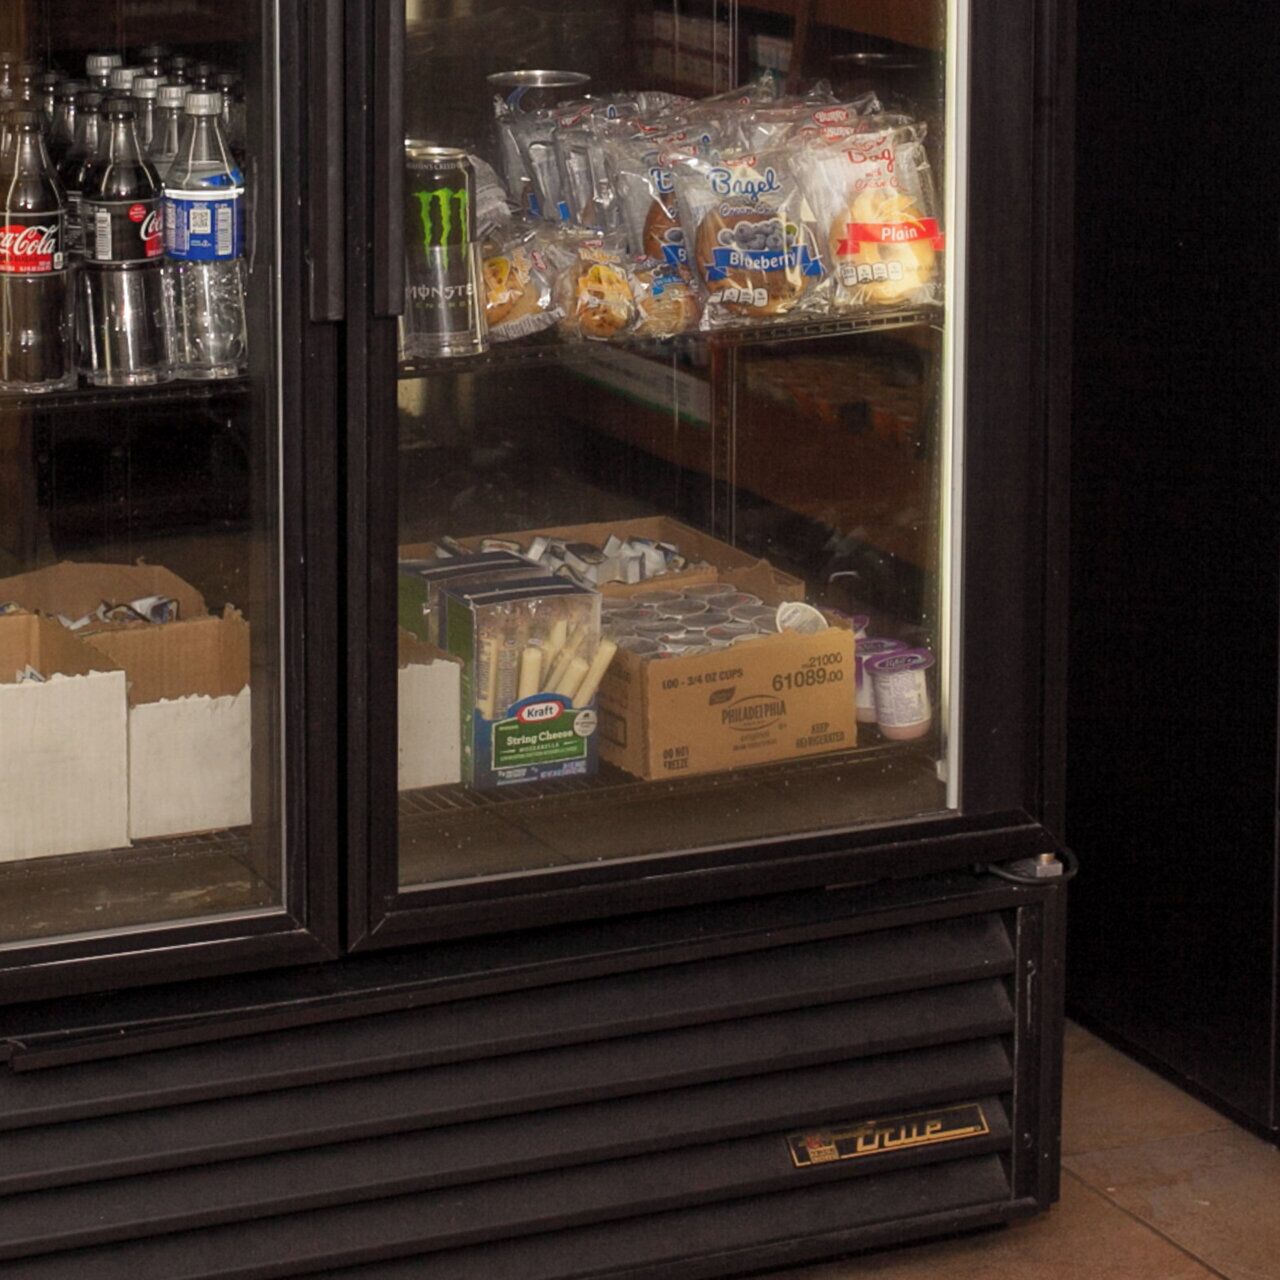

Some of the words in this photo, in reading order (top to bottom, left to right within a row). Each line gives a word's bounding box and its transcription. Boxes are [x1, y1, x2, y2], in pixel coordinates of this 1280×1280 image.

[708, 167, 780, 200] Bagel
[881, 224, 918, 241] Plain
[729, 251, 797, 269] Blueberry
[772, 669, 843, 692] 61089.00
[527, 705, 554, 718] Kraft
[721, 700, 787, 725] PHILADELPHIA
[506, 734, 538, 746] String
[538, 730, 574, 741] Cheese
